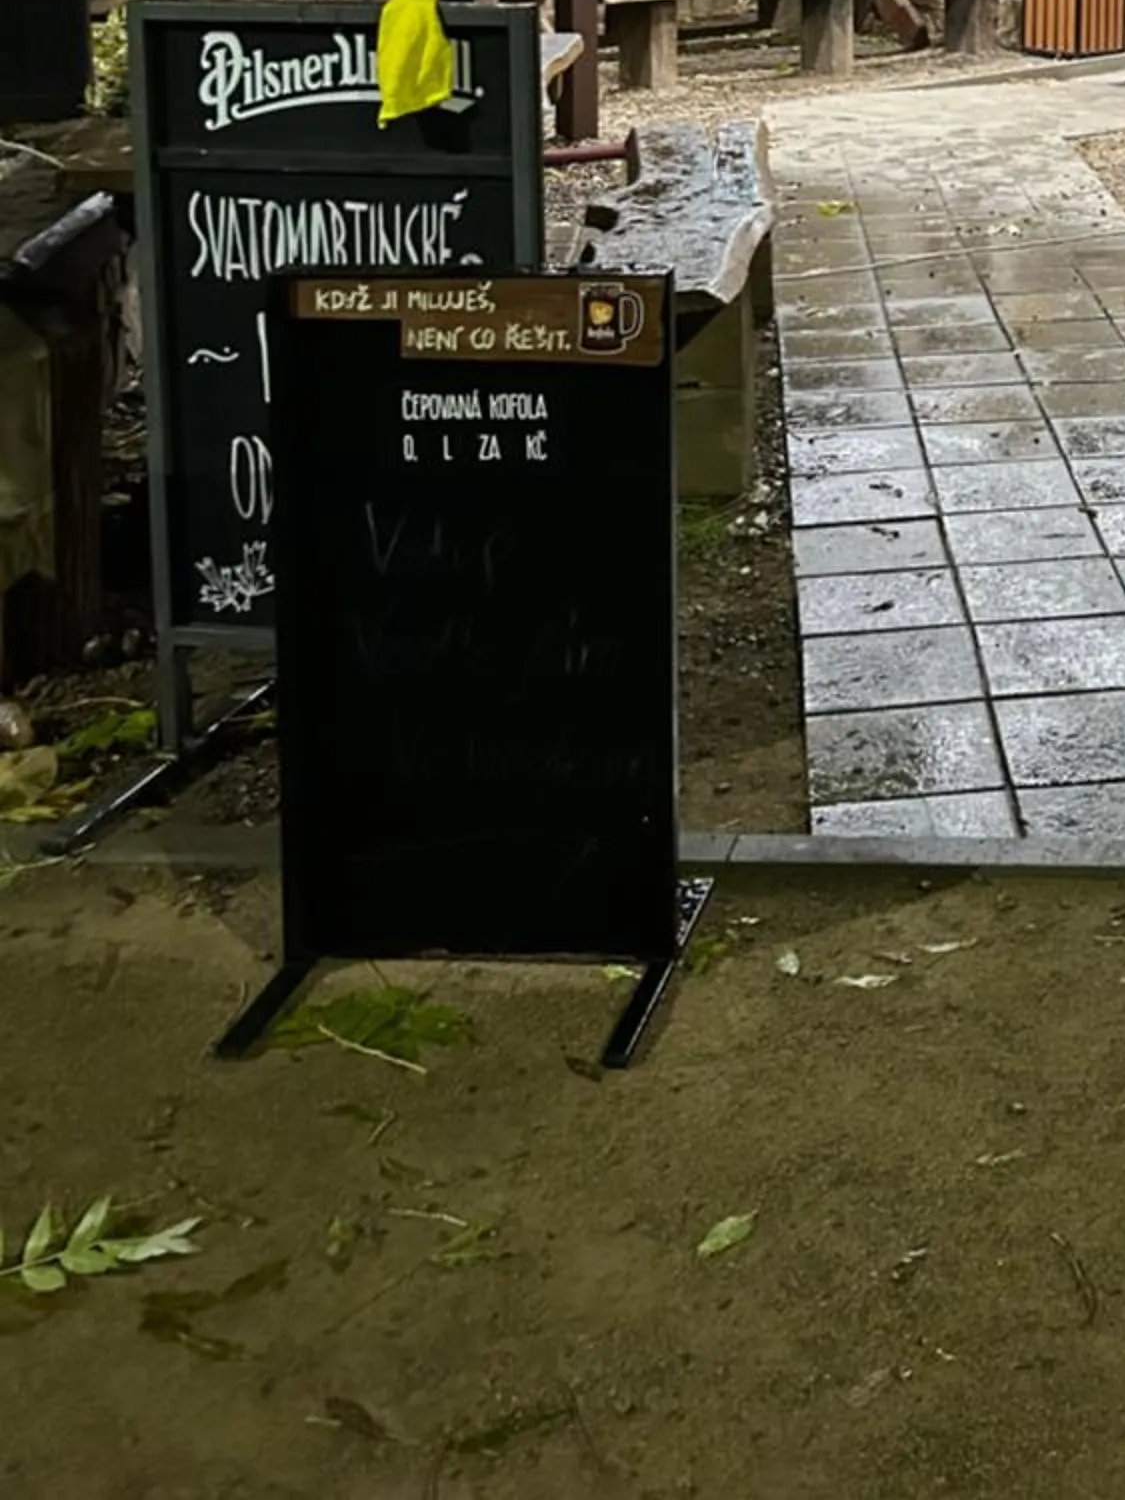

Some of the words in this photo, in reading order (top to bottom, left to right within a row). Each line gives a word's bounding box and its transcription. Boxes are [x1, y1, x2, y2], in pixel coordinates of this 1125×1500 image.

[314, 283, 373, 312] KDYŽ
[380, 290, 398, 310] JI
[406, 280, 496, 315] MILUJEŠ,
[406, 324, 465, 352] NENÍ
[469, 326, 496, 351] CO
[504, 322, 572, 352] ŘEŠIT.
[401, 387, 483, 421] ČEPOVANÁ
[489, 392, 549, 421] KOFOLA
[442, 433, 455, 462] L
[477, 433, 503, 462] ZA
[525, 429, 549, 462] KČ
